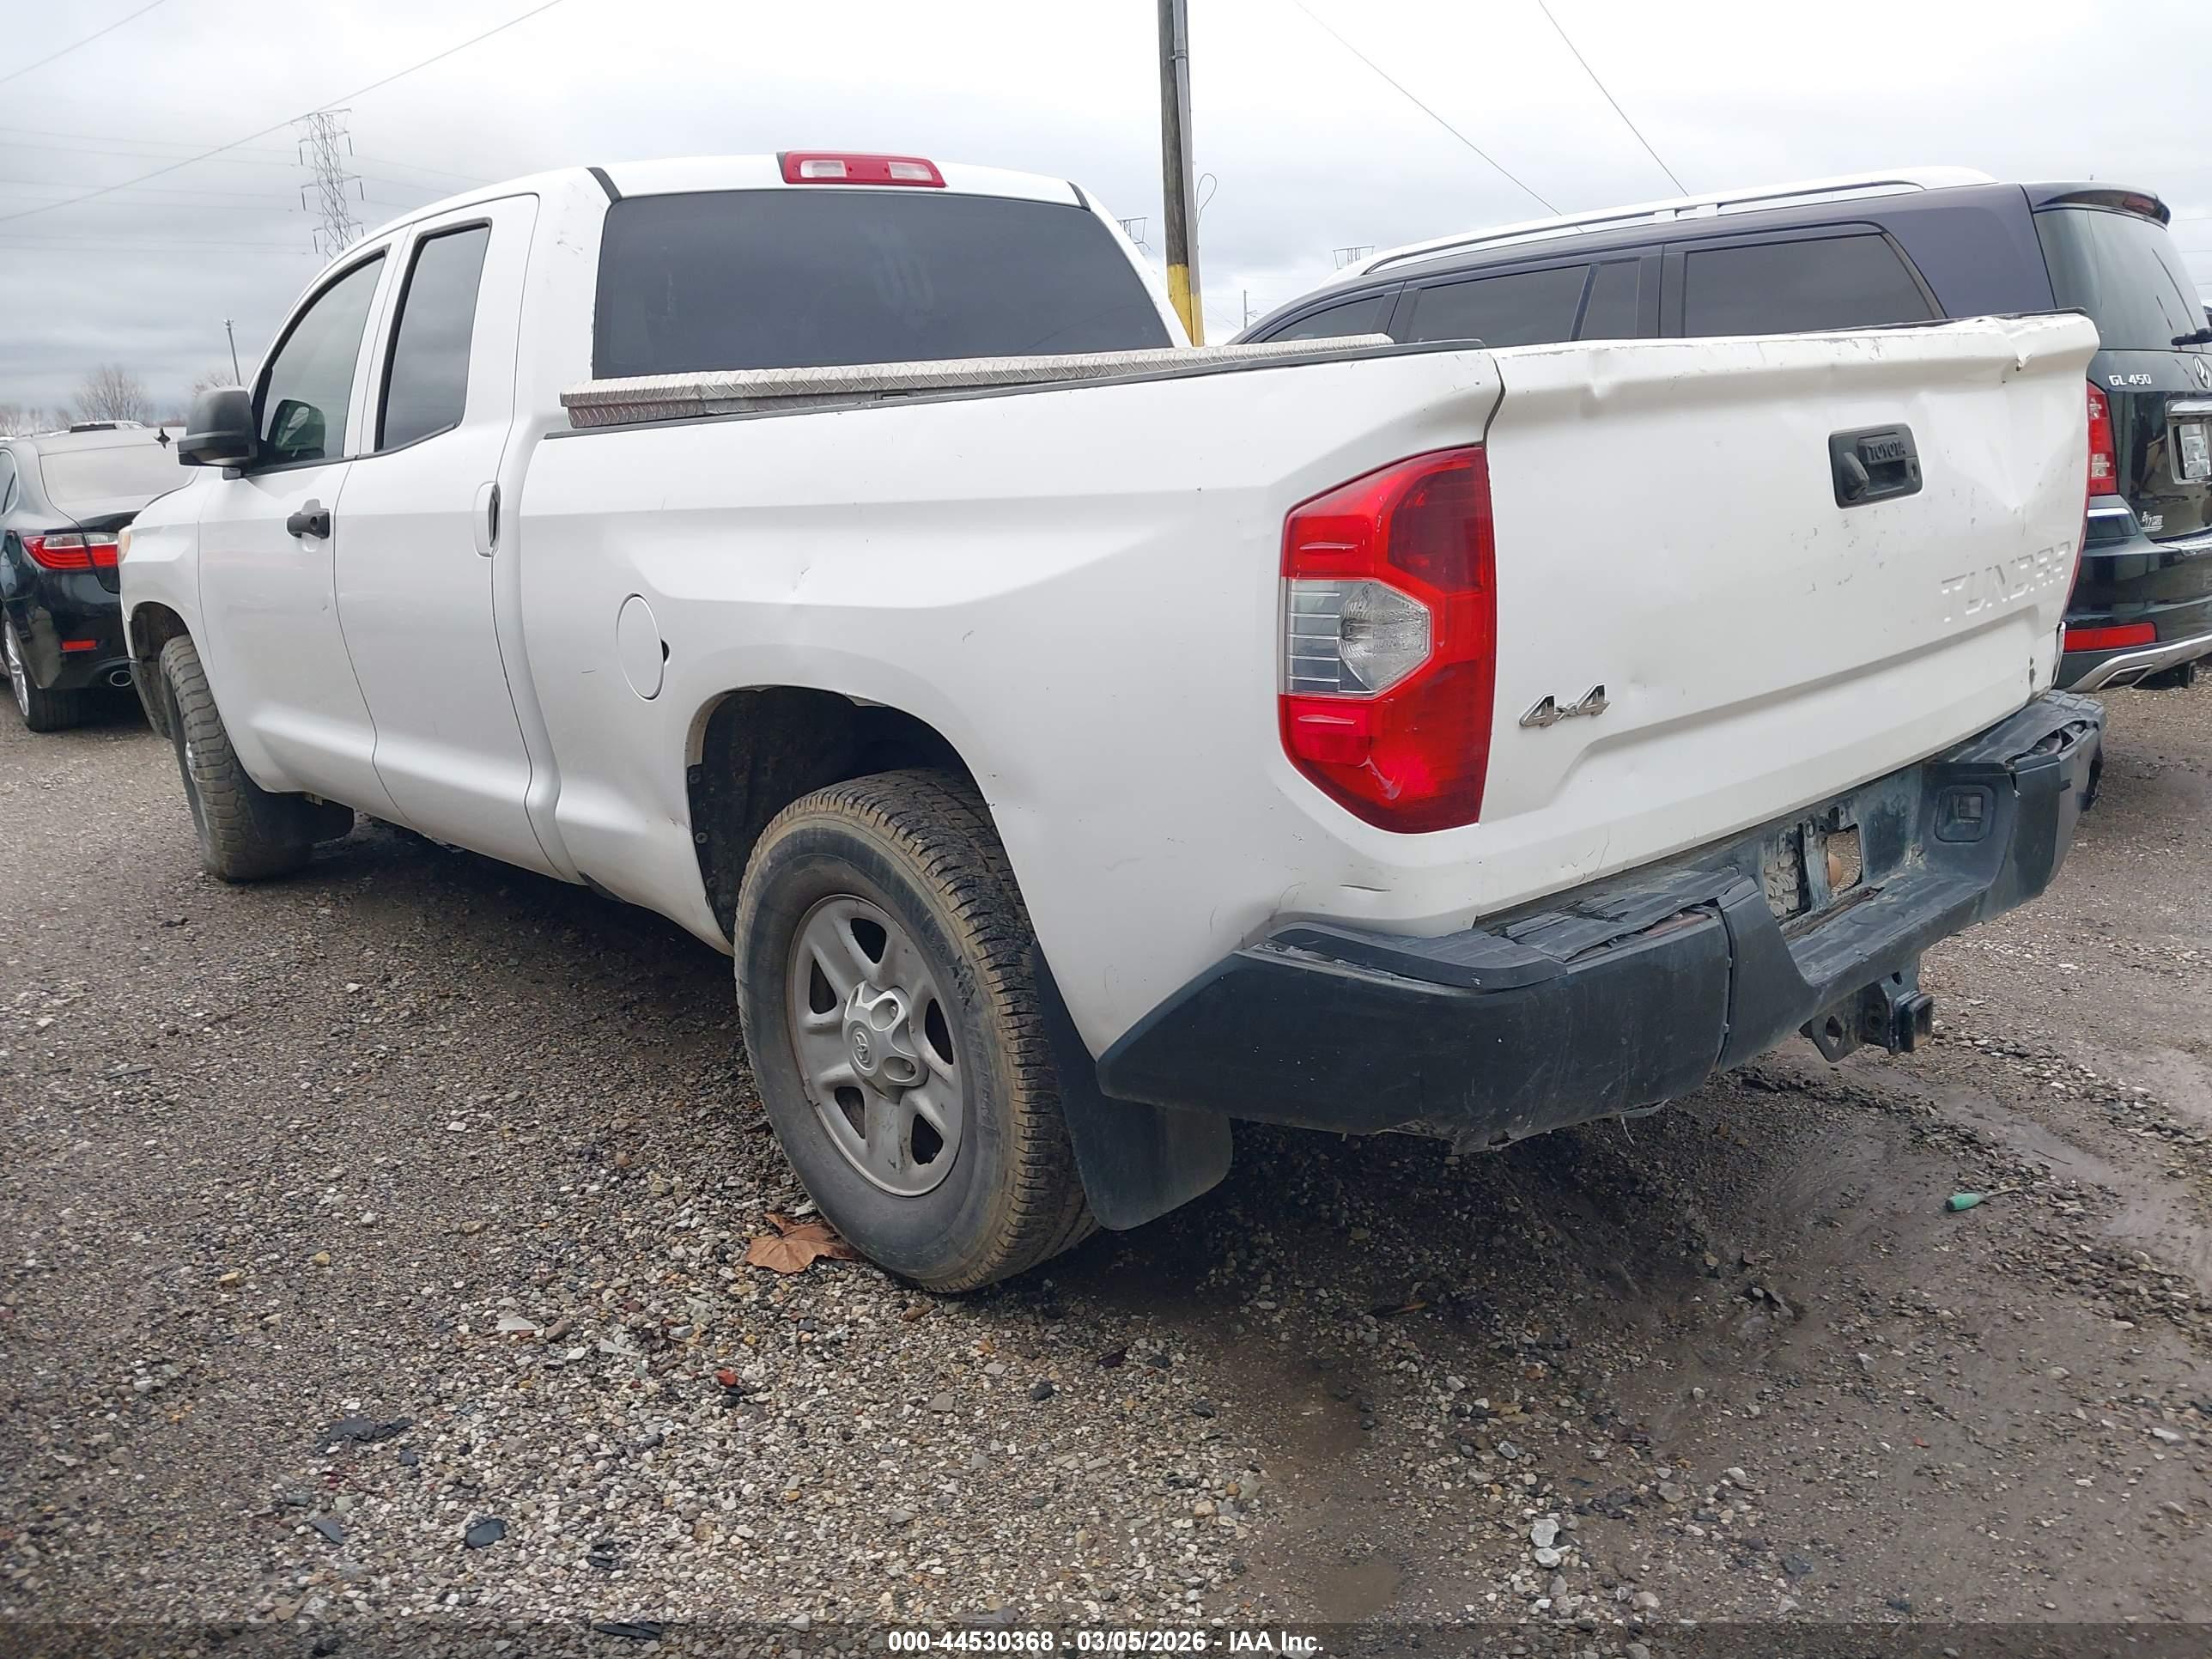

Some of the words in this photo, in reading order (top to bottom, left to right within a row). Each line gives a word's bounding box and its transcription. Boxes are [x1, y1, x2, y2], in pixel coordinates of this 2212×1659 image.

[2108, 374, 2127, 386] GL
[2128, 374, 2152, 386] 450
[1867, 440, 1907, 461] TOYOTA
[1941, 541, 2071, 623] TUNDRA
